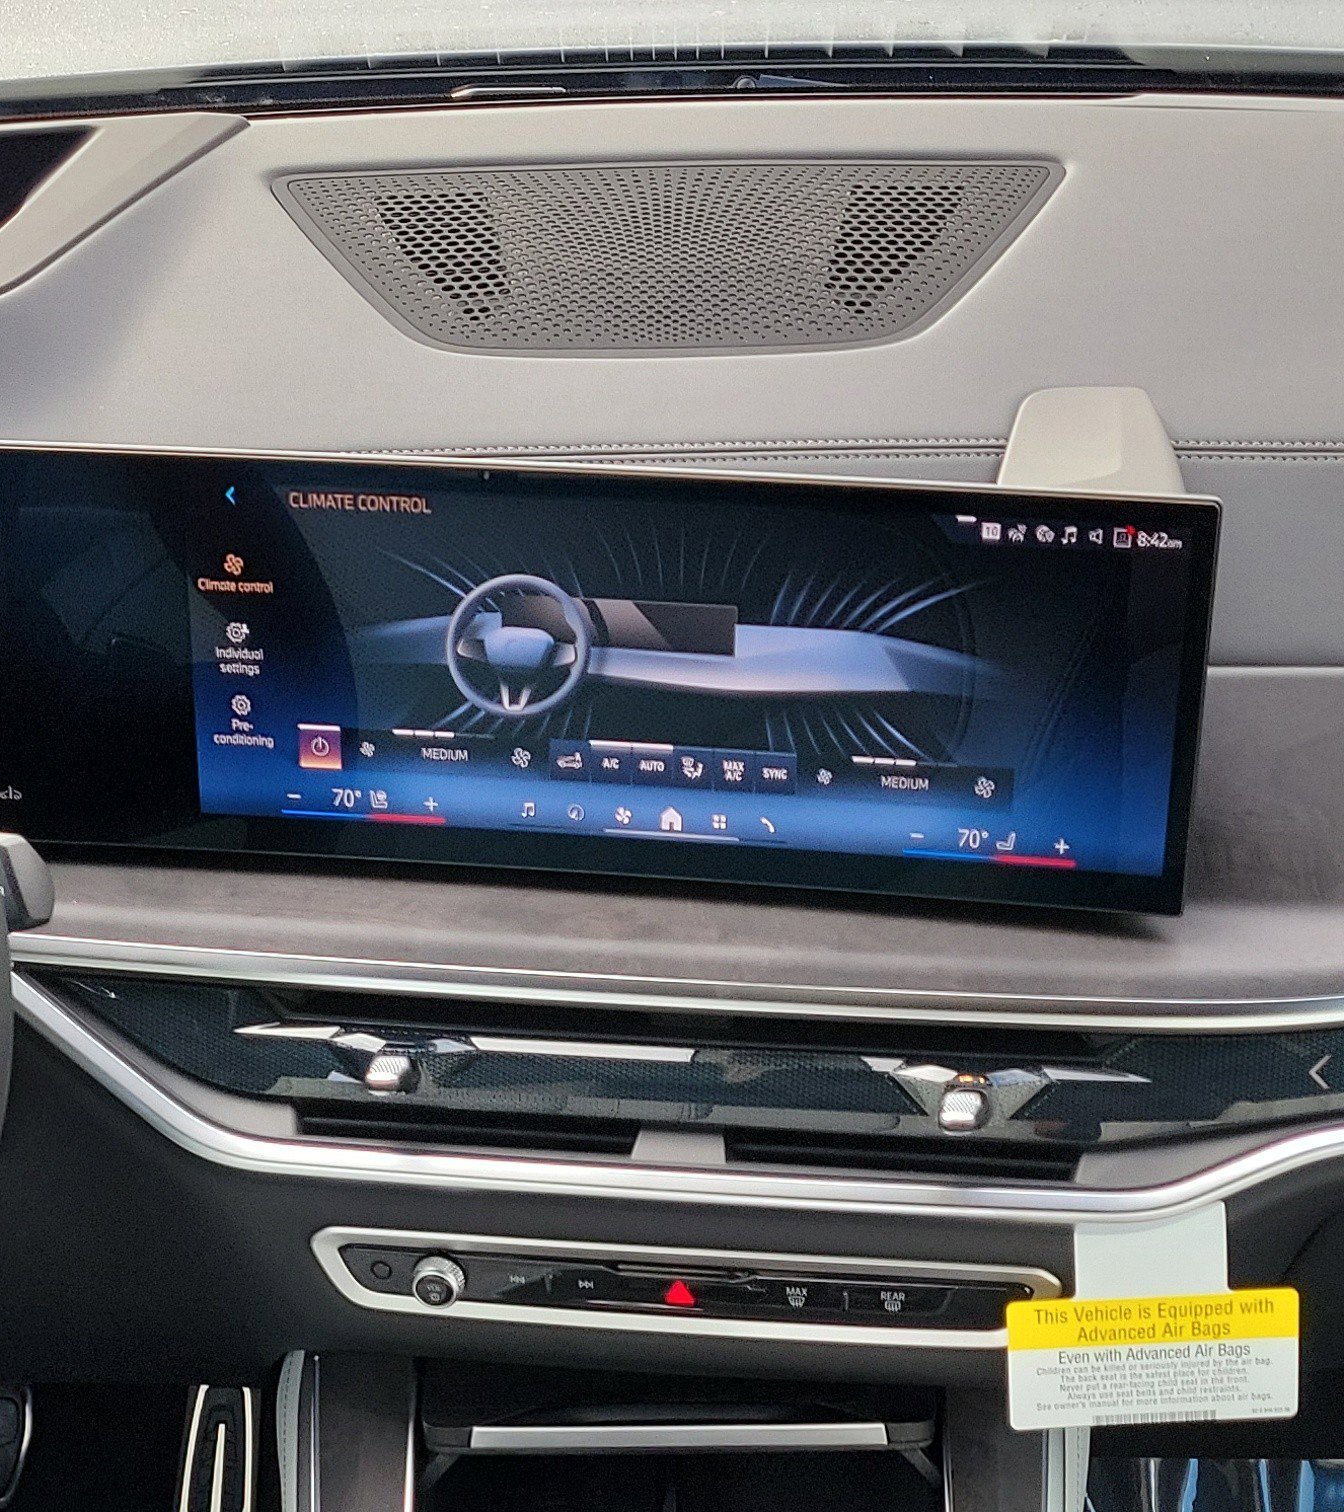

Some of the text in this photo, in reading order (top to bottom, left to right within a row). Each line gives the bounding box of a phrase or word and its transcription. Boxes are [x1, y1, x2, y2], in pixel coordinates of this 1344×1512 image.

[289, 492, 431, 514] CLIMATE CONTROL
[197, 578, 273, 594] Climate control
[215, 646, 264, 661] Individual
[219, 661, 260, 676] settings
[230, 719, 254, 733] Pre-
[213, 732, 274, 749] conditioning
[422, 748, 468, 763] MEDIUM
[602, 757, 620, 770] A/C
[640, 759, 665, 772] AUTO
[723, 760, 745, 771] MAX
[724, 770, 743, 782] A/C
[763, 767, 788, 781] SYNC
[881, 776, 929, 792] MEDIUM
[786, 1287, 807, 1297] MAX
[881, 1291, 905, 1301] REAR
[1035, 1298, 1274, 1324] This Vehicle is Equipped with
[1078, 1321, 1231, 1342] Advanced Air Bags
[1058, 1343, 1250, 1364] Even with Advanced Air Bags
[1036, 1367, 1071, 1375] Children
